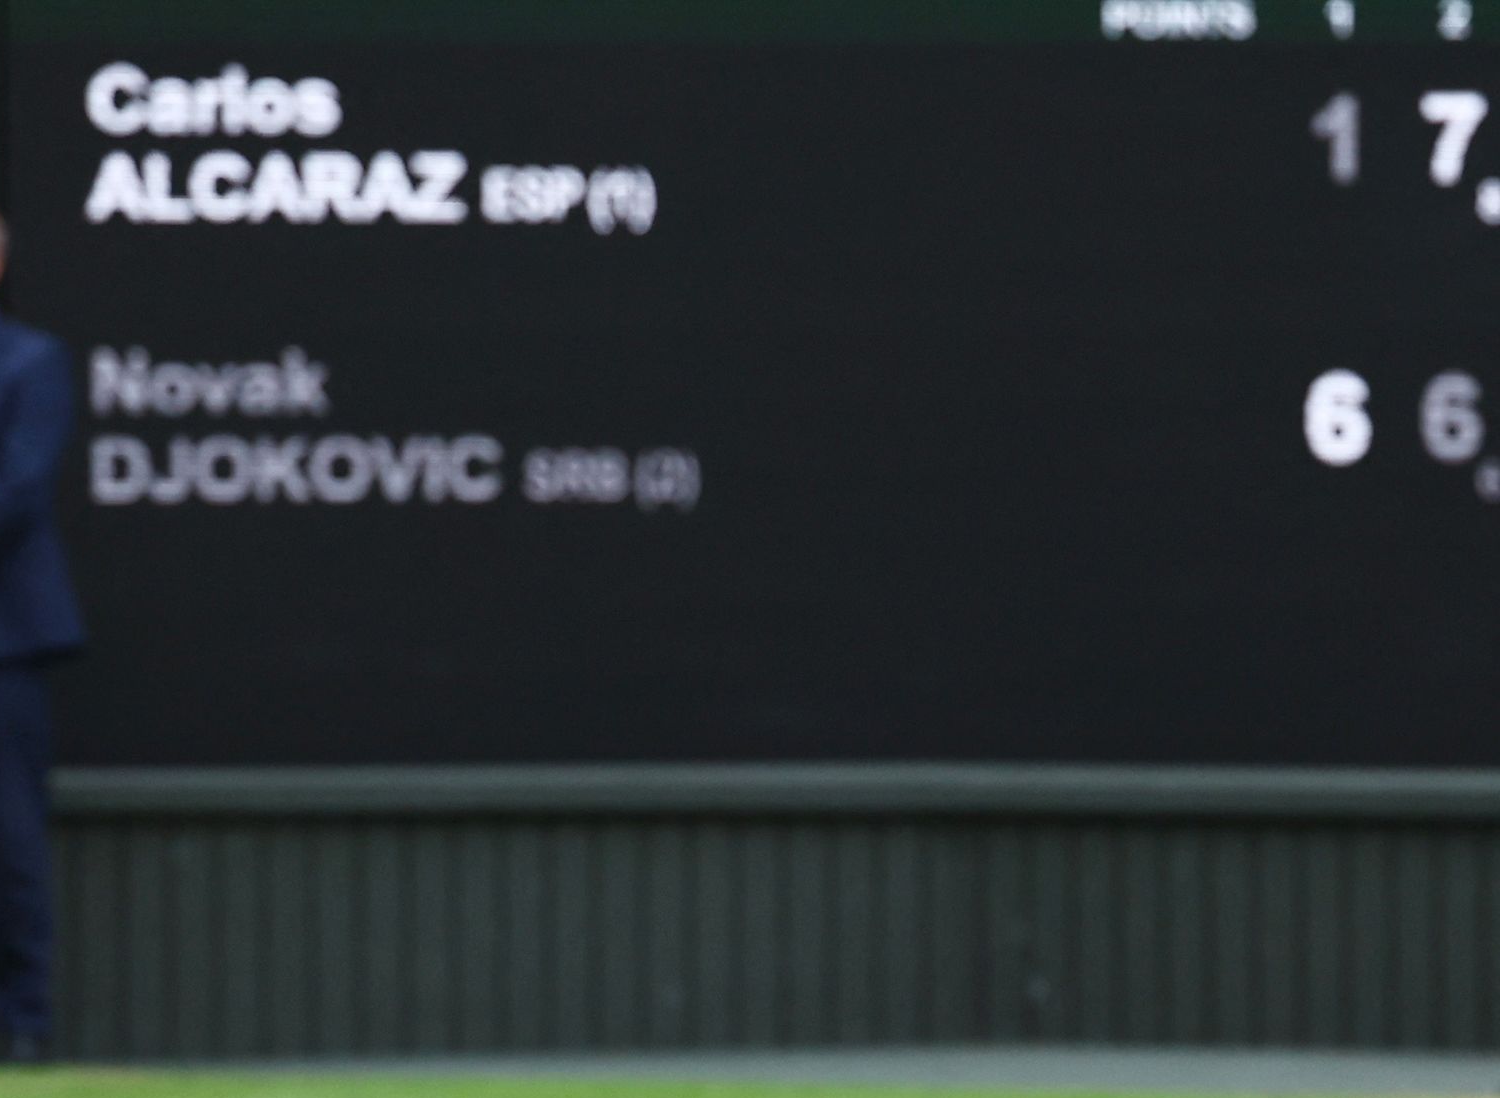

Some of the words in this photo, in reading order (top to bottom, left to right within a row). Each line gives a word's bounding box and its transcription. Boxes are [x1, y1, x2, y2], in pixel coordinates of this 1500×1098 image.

[1100, 0, 1257, 40] POINTS
[1324, 0, 1355, 38] 1
[84, 61, 343, 138] Carlos
[1312, 92, 1359, 183] 1
[1418, 90, 1489, 187] 7
[84, 149, 469, 225] ALCARAZ
[480, 164, 586, 223] ESP
[90, 347, 327, 415] Novak
[1303, 368, 1373, 467] 6
[1420, 371, 1485, 463] 6
[90, 435, 502, 504] DJOKOVIC
[523, 449, 630, 502] SRB
